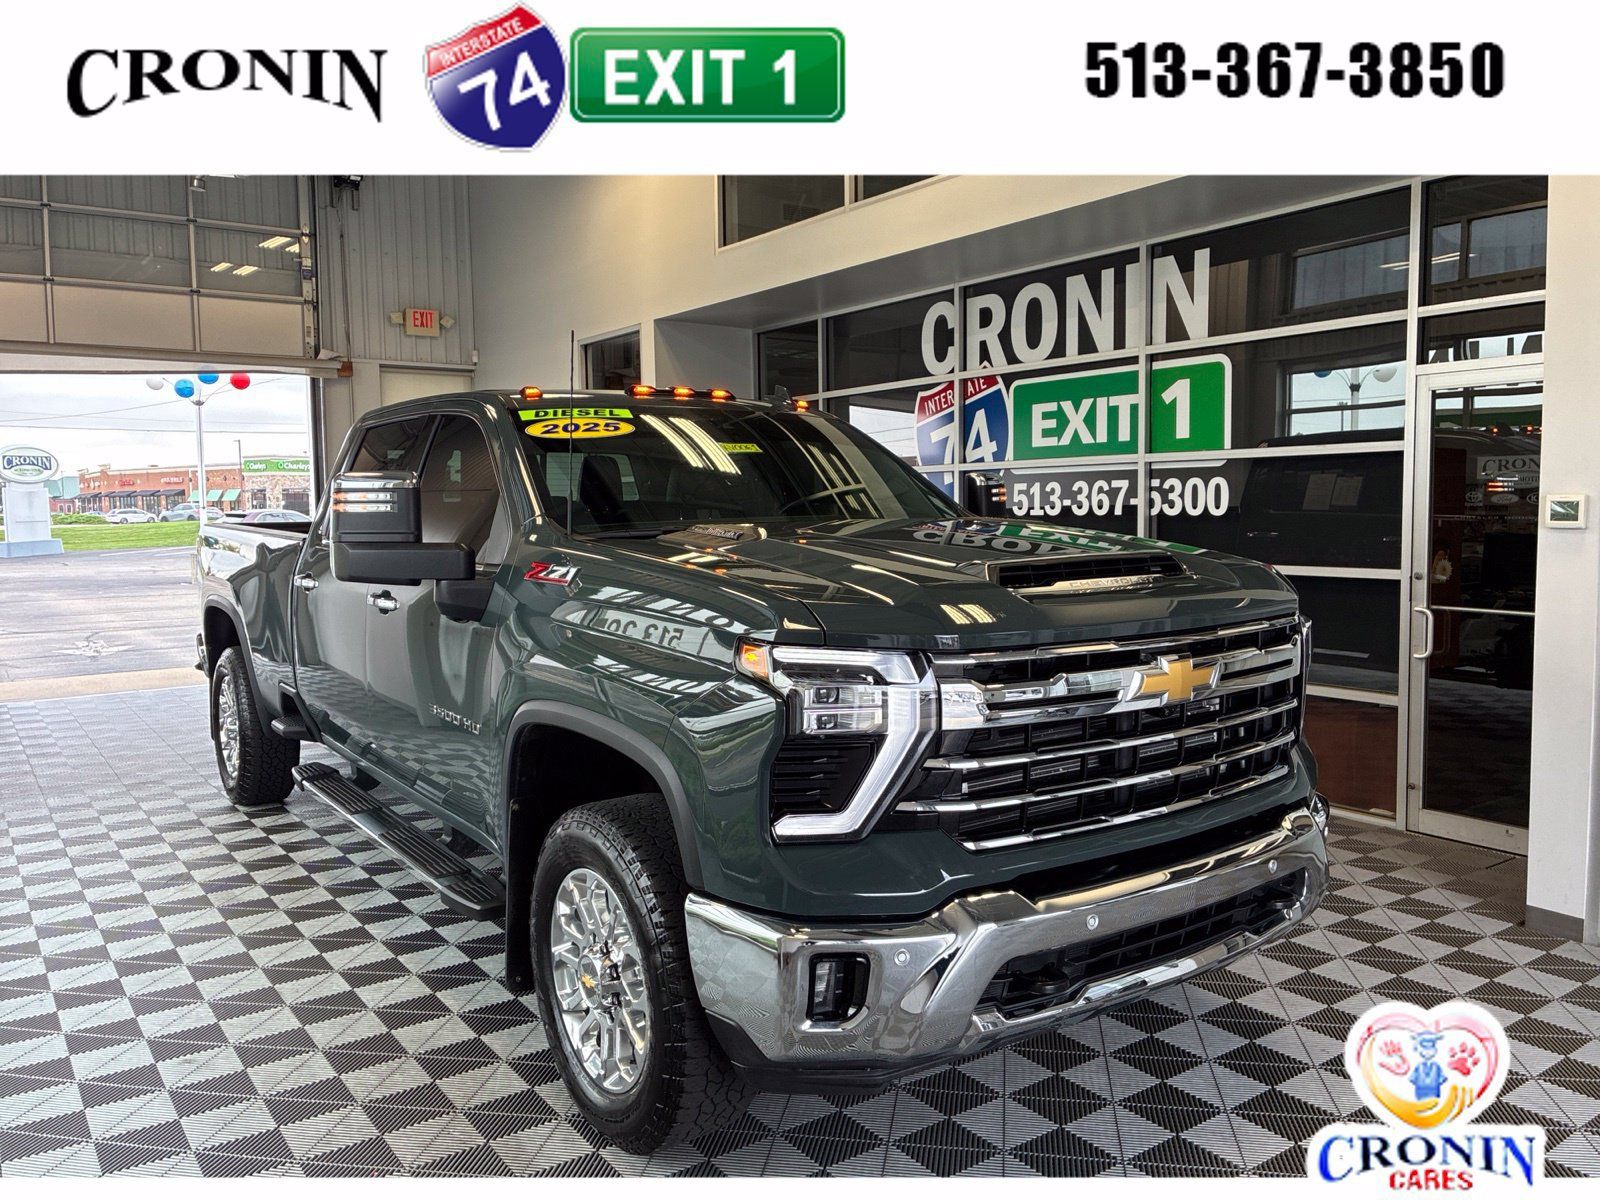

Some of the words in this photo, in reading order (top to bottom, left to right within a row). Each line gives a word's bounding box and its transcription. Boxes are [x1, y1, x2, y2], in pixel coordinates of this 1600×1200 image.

[412, 311, 433, 328] EXIT
[921, 247, 1211, 376] CRONIN
[924, 377, 988, 417] INTERATE
[534, 408, 621, 418] DIESEL
[1031, 394, 1140, 449] EXIT
[1160, 378, 1191, 439] 1
[541, 421, 621, 435] 2025
[930, 408, 998, 485] 74
[3, 455, 51, 470] CRONIN
[523, 561, 581, 586] Z71
